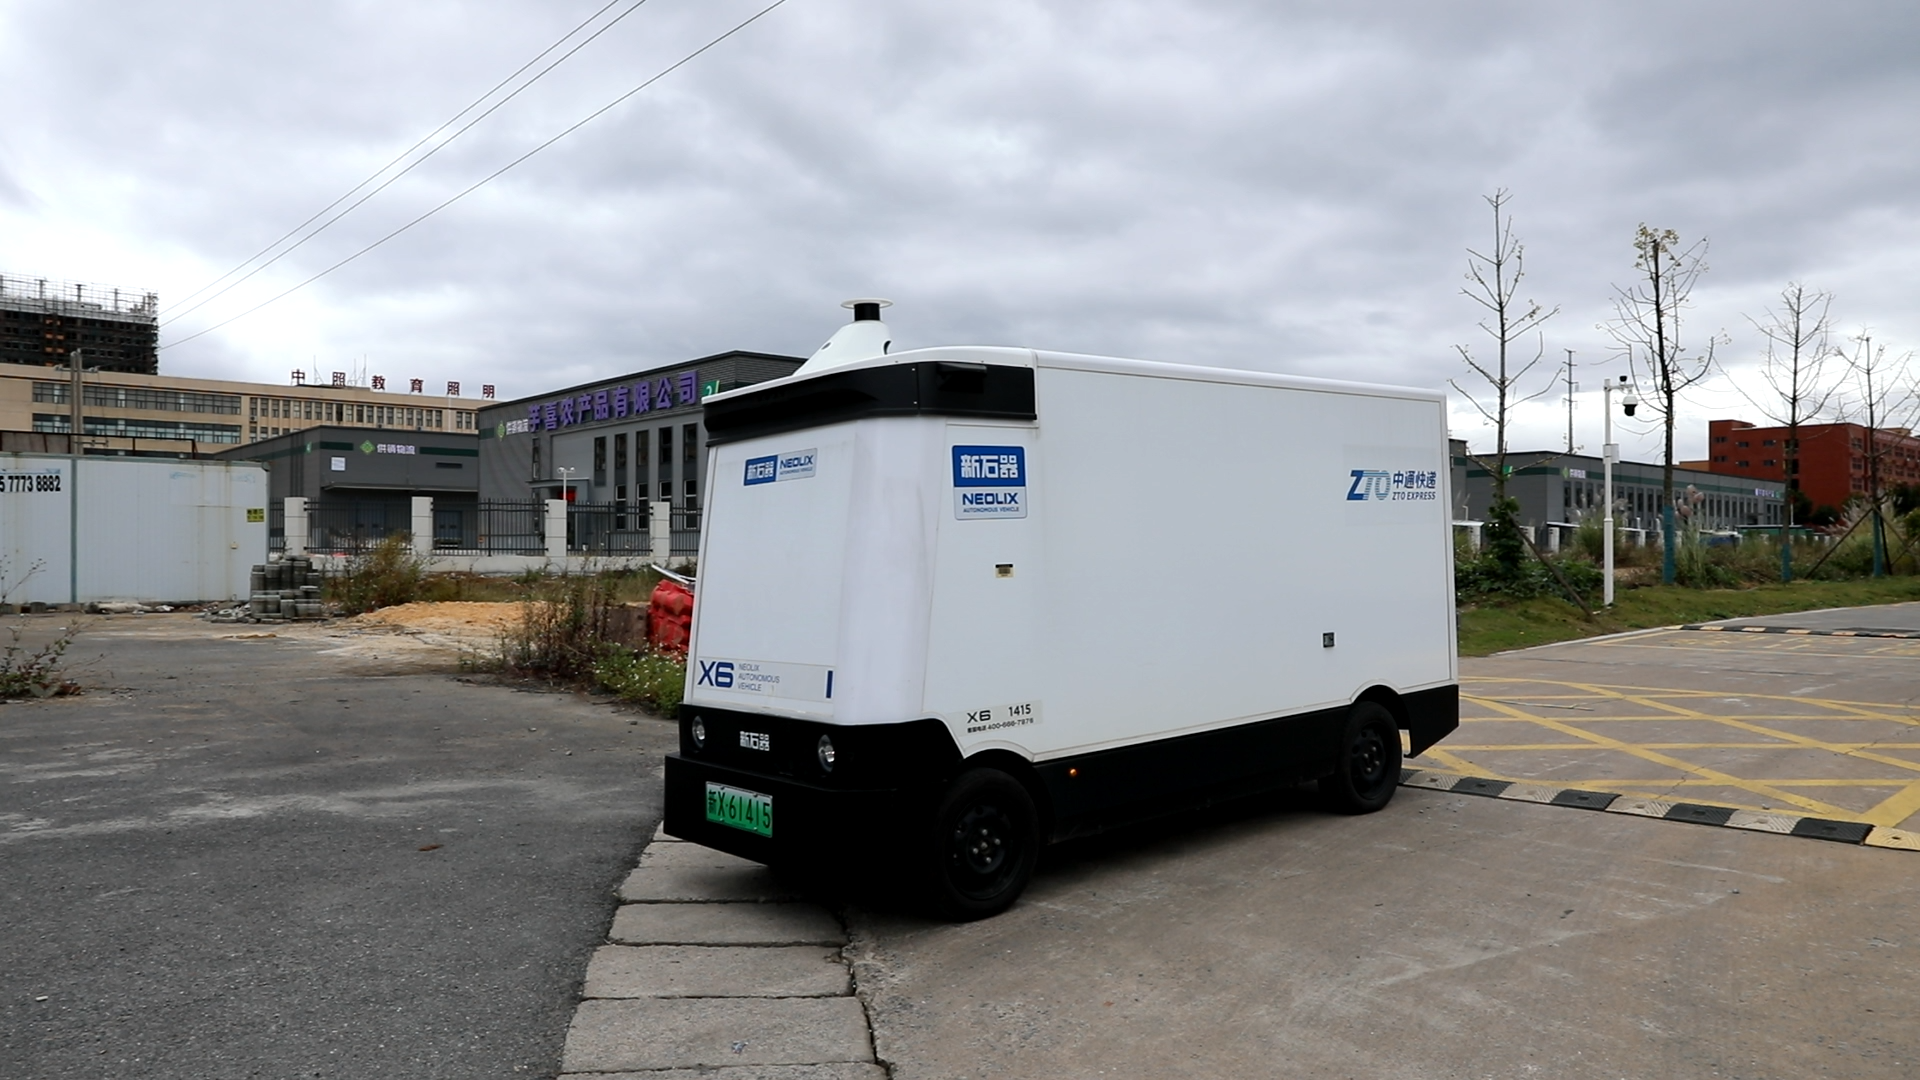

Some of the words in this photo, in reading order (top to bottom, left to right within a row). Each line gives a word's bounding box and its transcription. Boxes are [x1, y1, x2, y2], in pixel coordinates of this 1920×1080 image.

[291, 369, 495, 399] 中照教育照明
[747, 461, 775, 480] 新石器
[780, 455, 814, 469] NEOLIX
[960, 454, 1019, 479] 新石器
[8, 475, 33, 492] 7773
[36, 475, 61, 492] 8882
[1346, 469, 1391, 501] ZTO
[1392, 470, 1437, 489] 中通快递
[962, 492, 1019, 506] NEOLIX
[1392, 491, 1406, 501] ZTO
[1406, 491, 1437, 501] EXPRESS
[697, 660, 735, 689] X6
[738, 662, 760, 672] NEOLIX
[737, 681, 762, 692] VEHICLE
[738, 672, 780, 684] AUTONOMOUS
[967, 710, 991, 723] X6
[1008, 703, 1032, 717] 1415
[740, 730, 770, 751] 新石器
